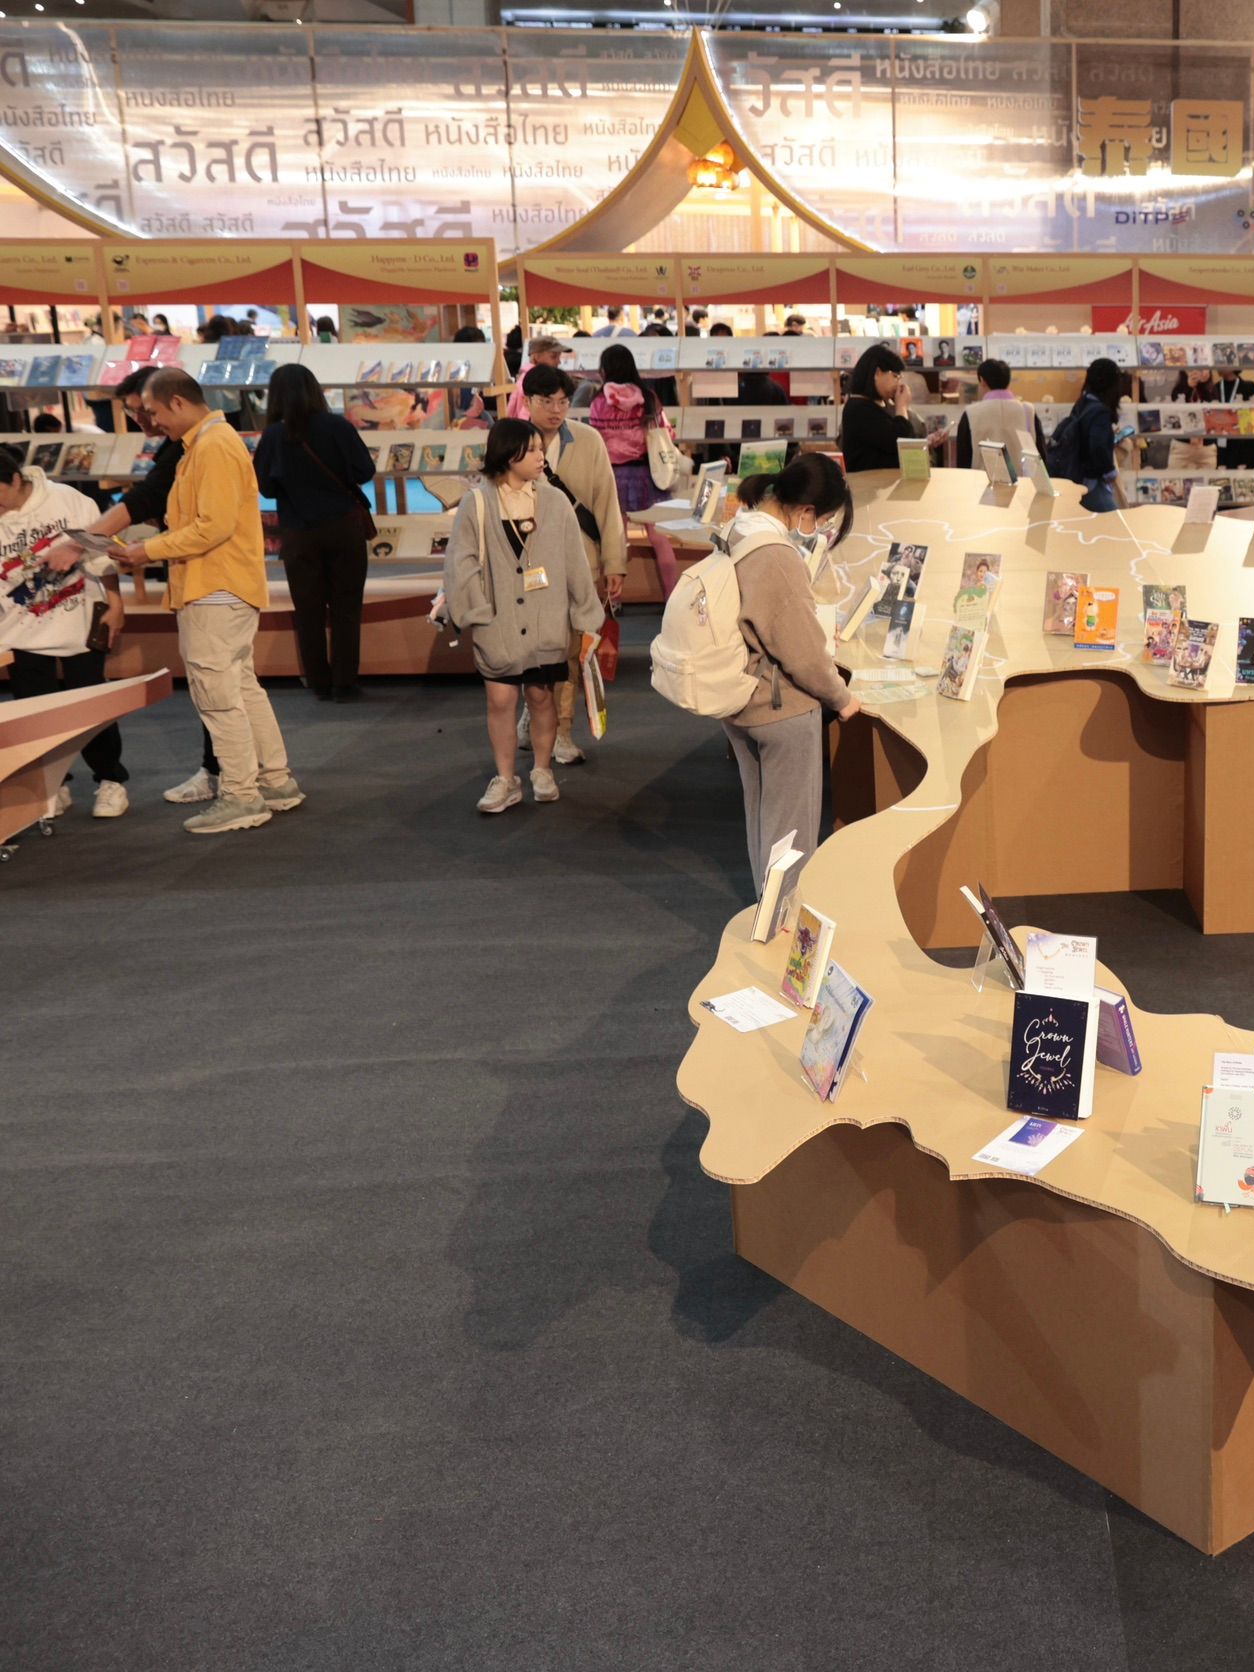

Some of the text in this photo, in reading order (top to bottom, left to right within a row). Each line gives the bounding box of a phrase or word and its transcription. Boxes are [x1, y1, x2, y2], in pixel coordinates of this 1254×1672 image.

[0, 103, 97, 128] นังสือไทย
[302, 106, 569, 148] สวัสดี หนังสือไทย
[584, 116, 661, 137] หนังสือไท
[130, 124, 280, 183] สวัสดี
[304, 157, 417, 184] หนังสือไทย
[1023, 1018, 1074, 1045] Crown
[1020, 1035, 1072, 1071] Jewel
